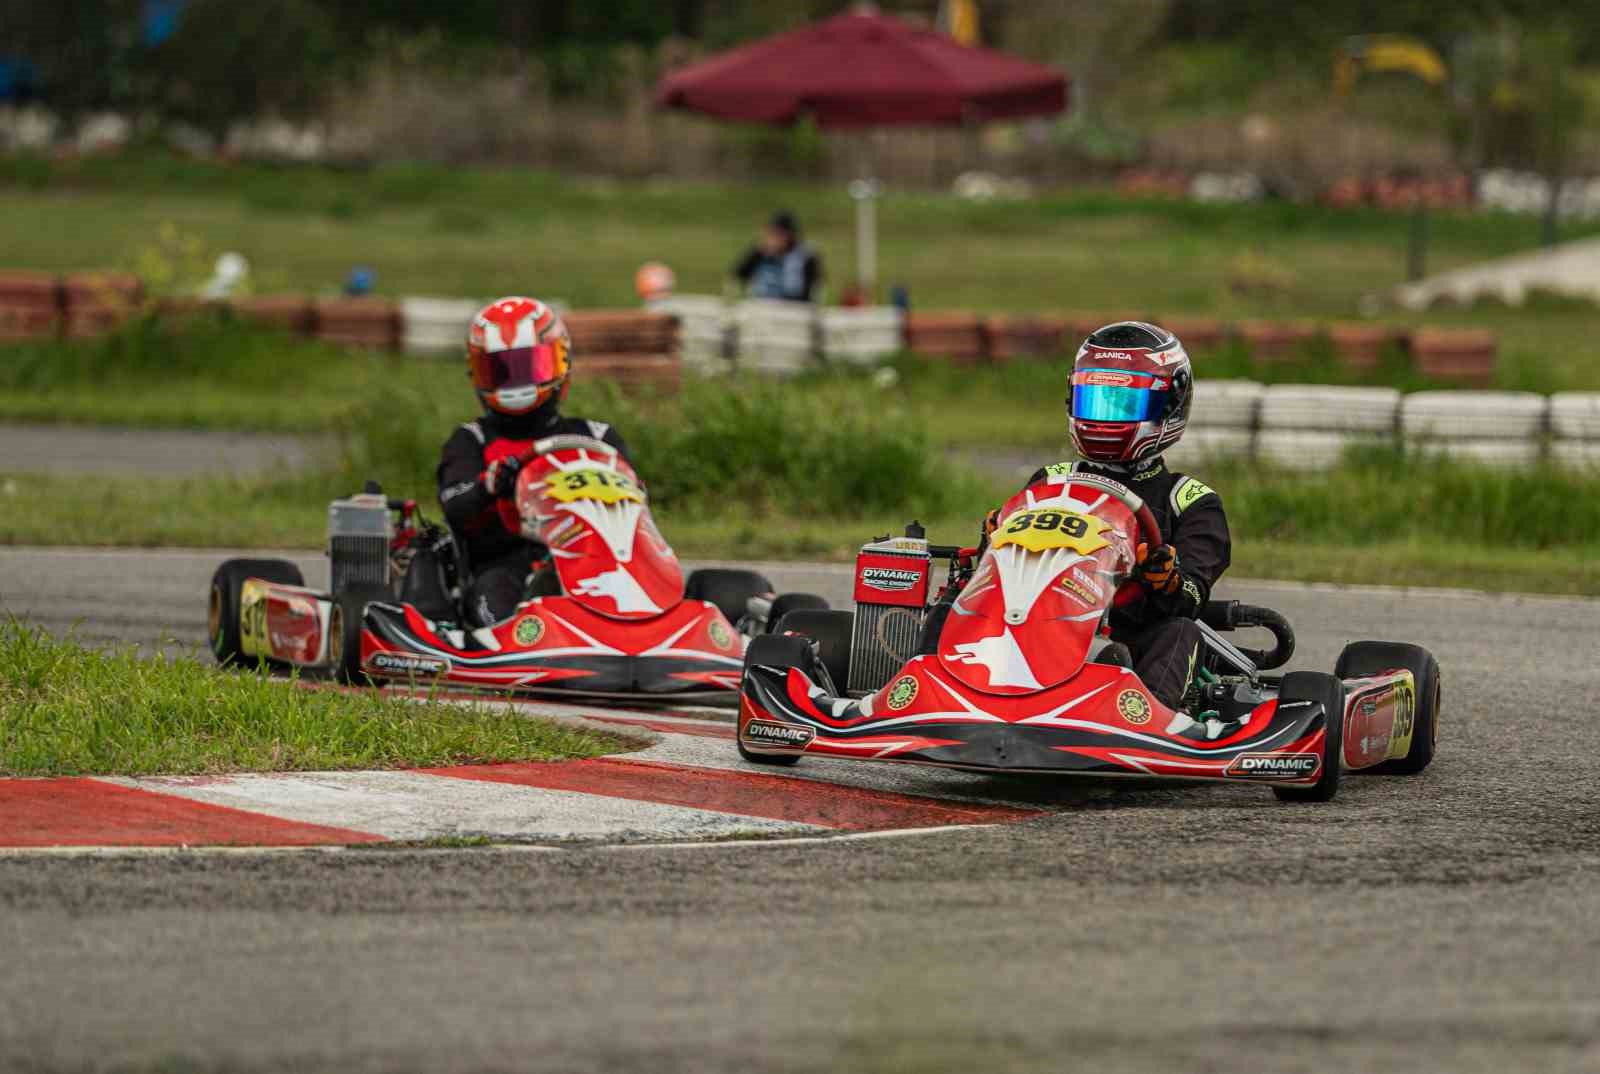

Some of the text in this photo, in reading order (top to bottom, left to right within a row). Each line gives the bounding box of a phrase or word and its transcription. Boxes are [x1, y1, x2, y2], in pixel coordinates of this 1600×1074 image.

[1094, 351, 1132, 360] SANICA
[1008, 512, 1089, 538] 399
[750, 724, 809, 741] DYNAMIC
[1242, 758, 1314, 769] DYNAMIC
